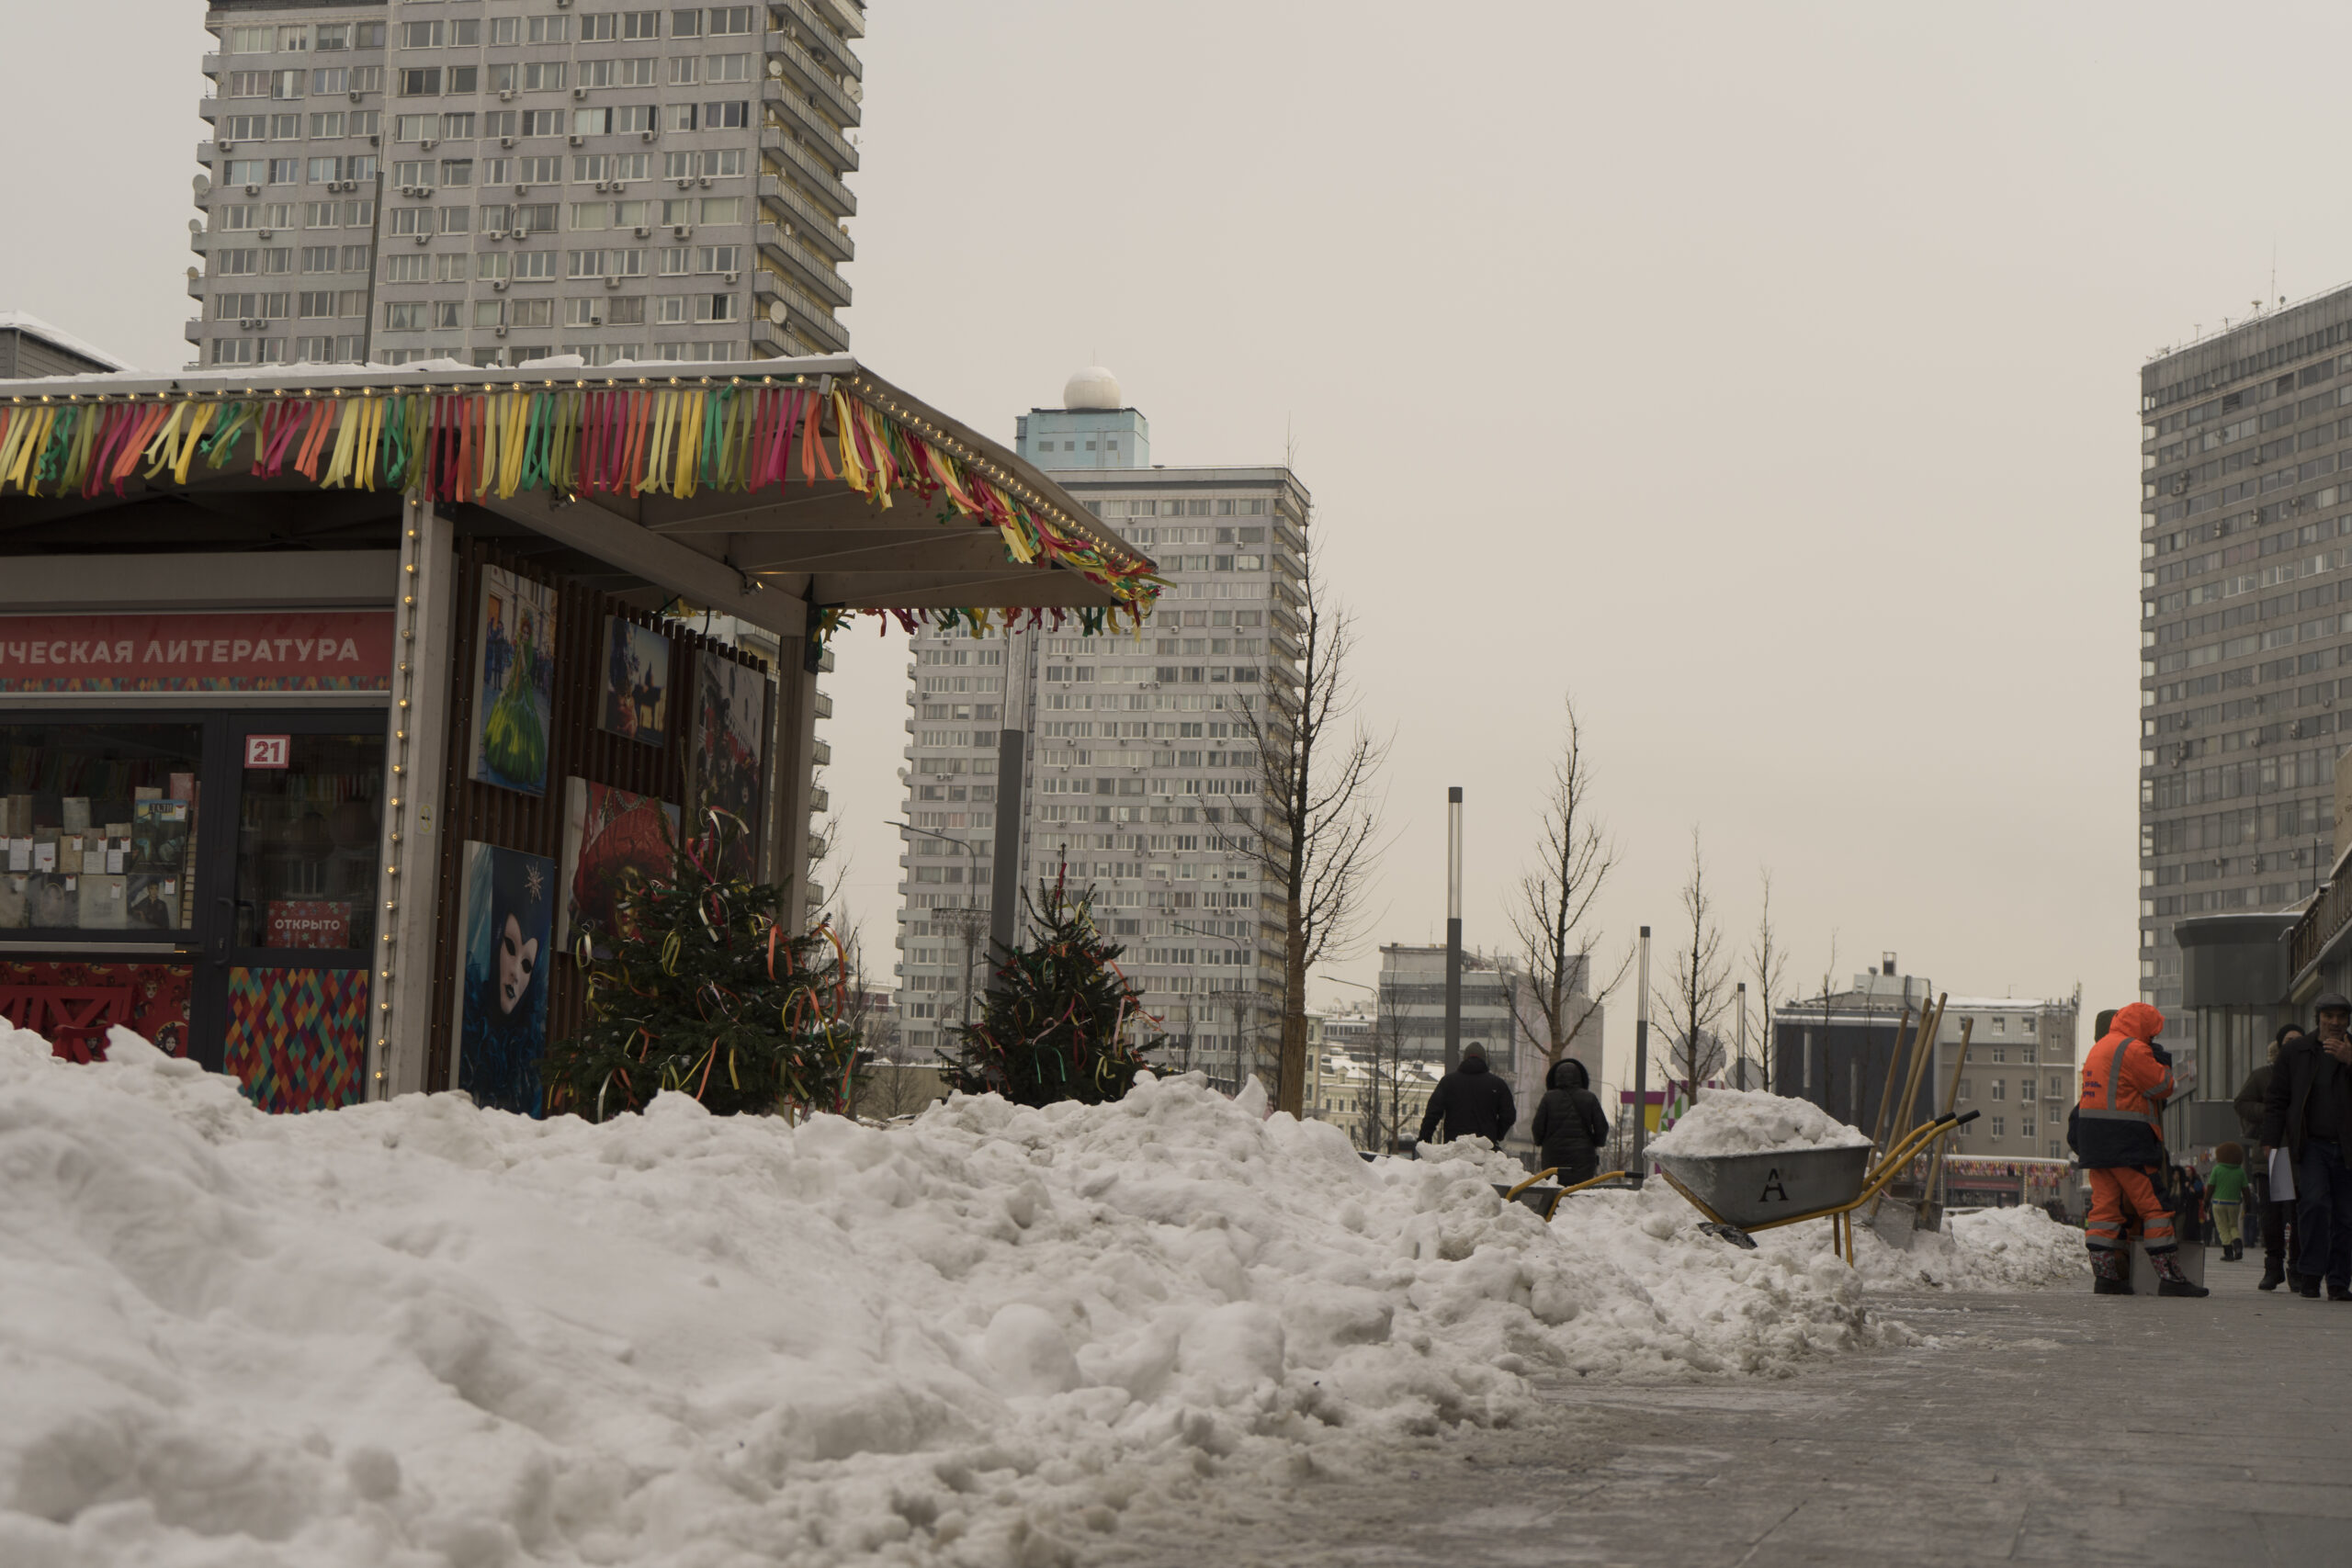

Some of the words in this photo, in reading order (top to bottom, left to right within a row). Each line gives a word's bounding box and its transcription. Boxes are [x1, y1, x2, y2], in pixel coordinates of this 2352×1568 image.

[0, 640, 133, 664] ЧЕСКАЯ
[143, 637, 360, 662] ЛИТЕРАТУРА
[254, 740, 279, 762] 21
[274, 919, 341, 931] ОТКРЫТО
